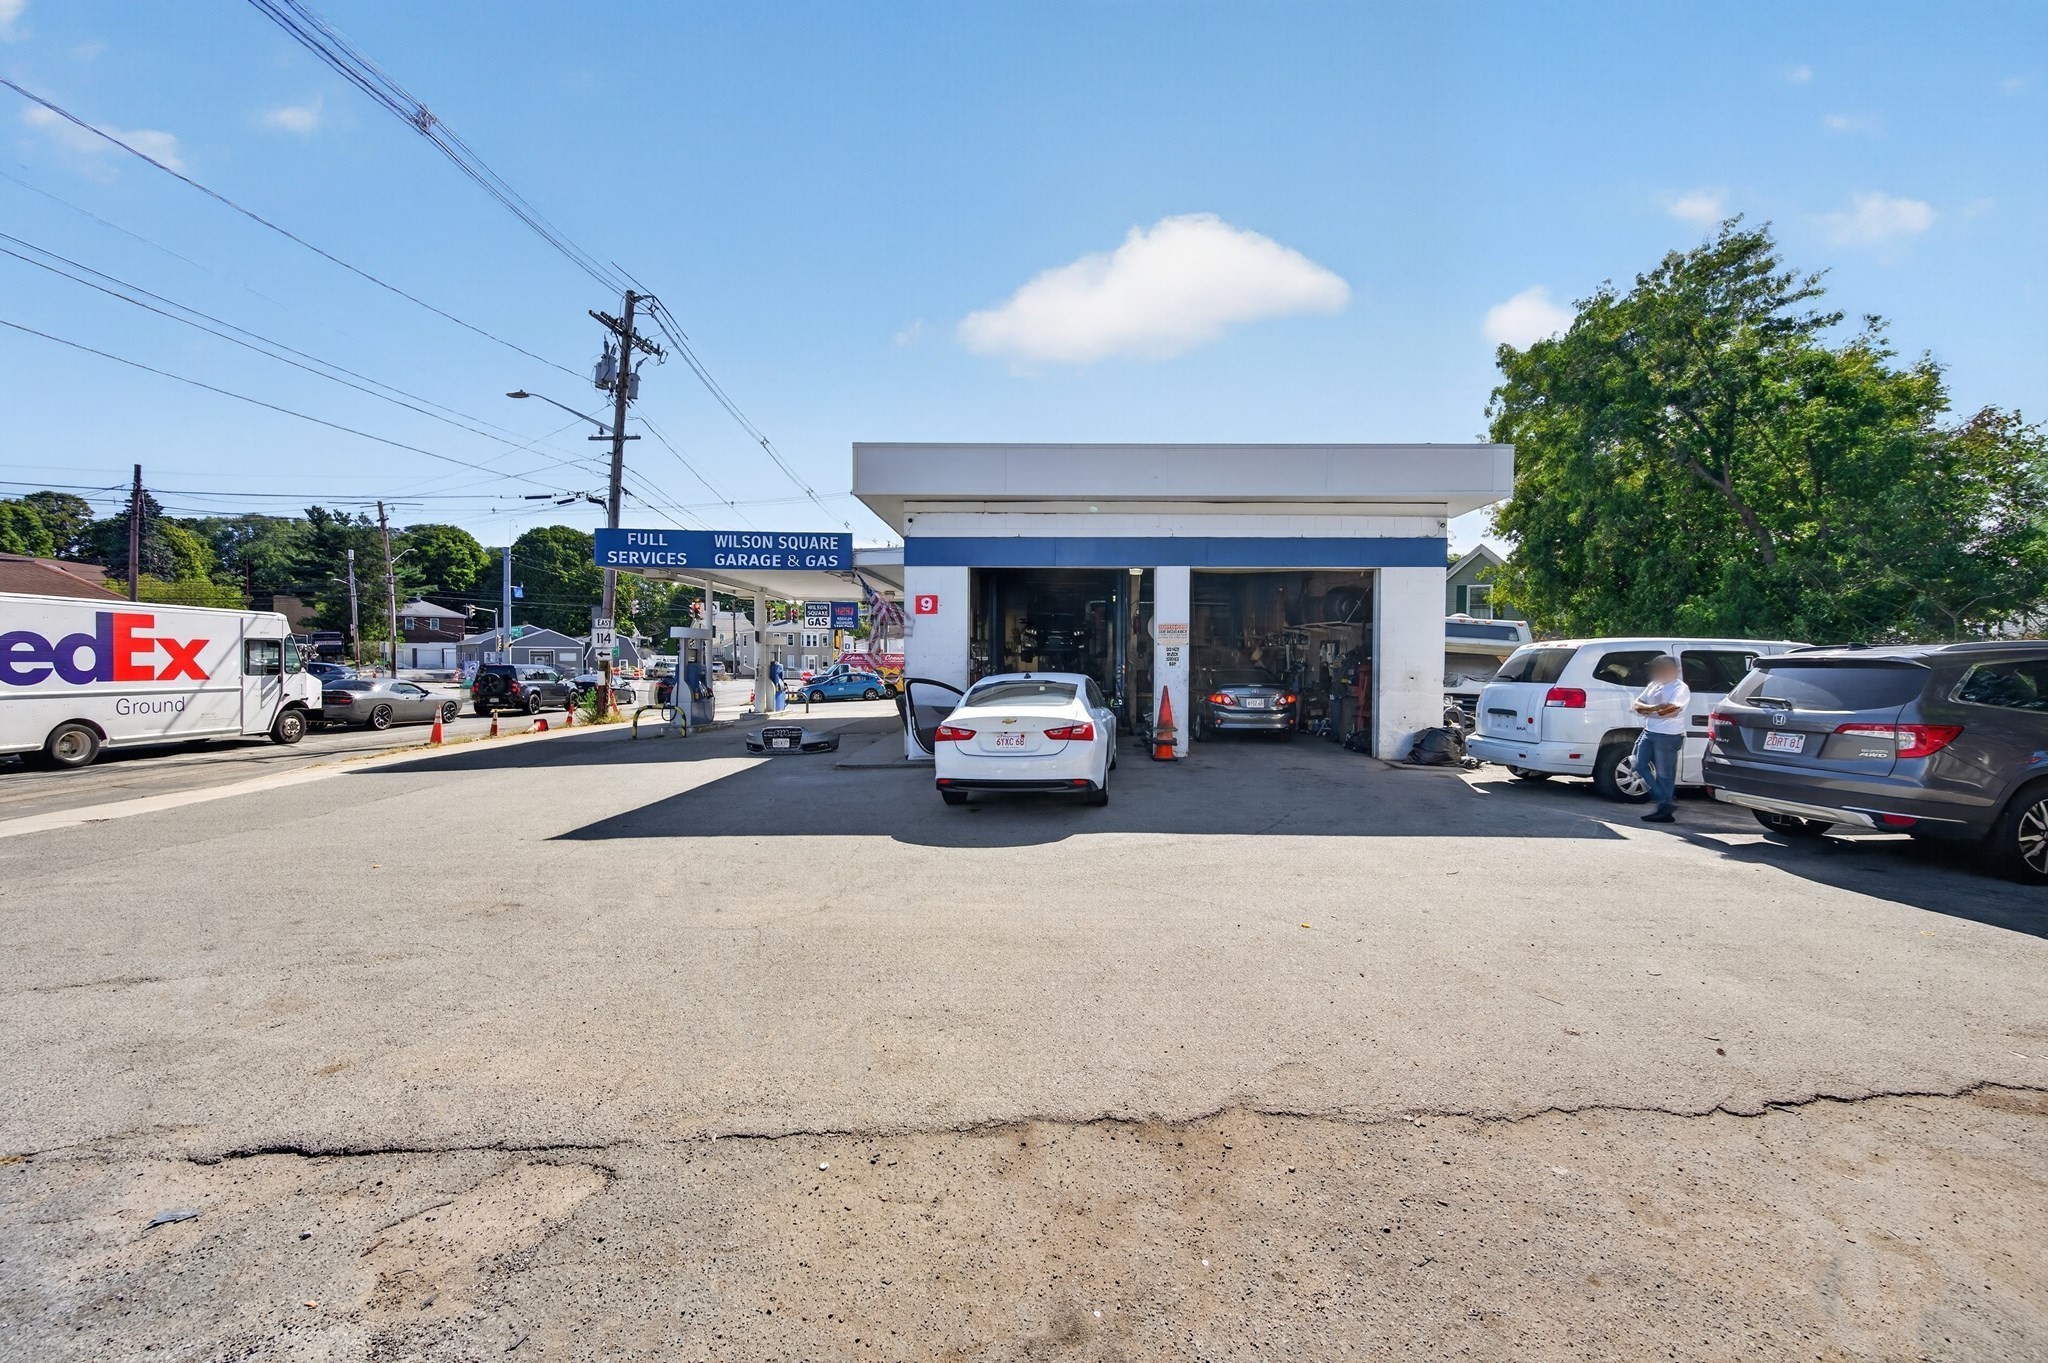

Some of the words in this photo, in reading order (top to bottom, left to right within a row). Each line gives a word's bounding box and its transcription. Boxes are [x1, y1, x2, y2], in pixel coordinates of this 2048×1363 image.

[627, 532, 668, 546] FULL
[714, 534, 773, 549] WILSON
[778, 536, 839, 550] SQUARE
[607, 550, 687, 565] SERVICES
[714, 553, 781, 567] GARAGE
[788, 555, 800, 567] &
[806, 554, 838, 567] GAS
[920, 597, 933, 611] 9
[807, 617, 828, 627] GAS
[596, 633, 612, 644] 114
[116, 696, 186, 716] Ground
